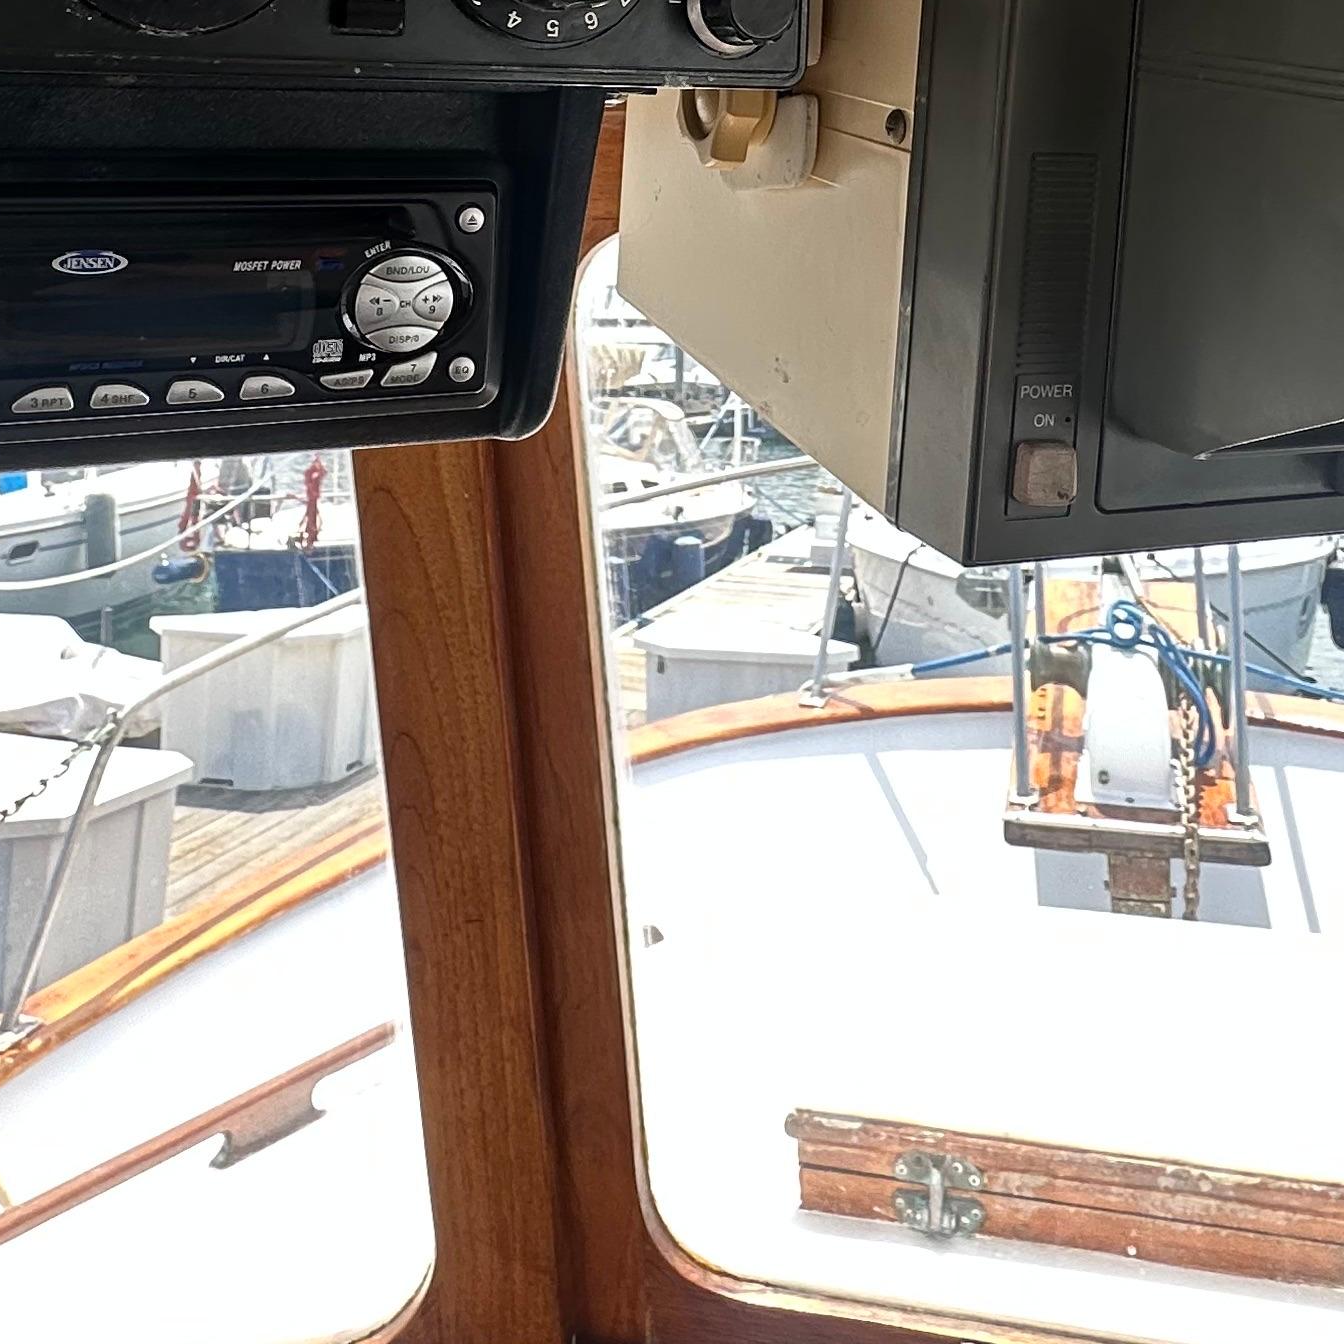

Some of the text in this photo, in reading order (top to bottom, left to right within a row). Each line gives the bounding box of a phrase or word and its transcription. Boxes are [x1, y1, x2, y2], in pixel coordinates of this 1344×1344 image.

[507, 11, 522, 28] 4
[546, 19, 559, 37] 5
[364, 241, 391, 258] ENTER
[64, 257, 116, 269] JENSEN
[233, 260, 302, 272] MOSFET POWER
[386, 266, 430, 276] BND/LOU
[399, 300, 411, 308] CH
[376, 307, 383, 316] 8
[428, 306, 436, 315] 9
[359, 353, 376, 362] MP3
[410, 364, 417, 372] 7
[455, 366, 470, 374] EQ
[188, 388, 197, 399] 5
[261, 383, 269, 394] 6
[1020, 384, 1073, 399] POWER
[30, 397, 65, 408] 3 RPT
[100, 393, 109, 404] 4
[1033, 413, 1055, 428] ON
